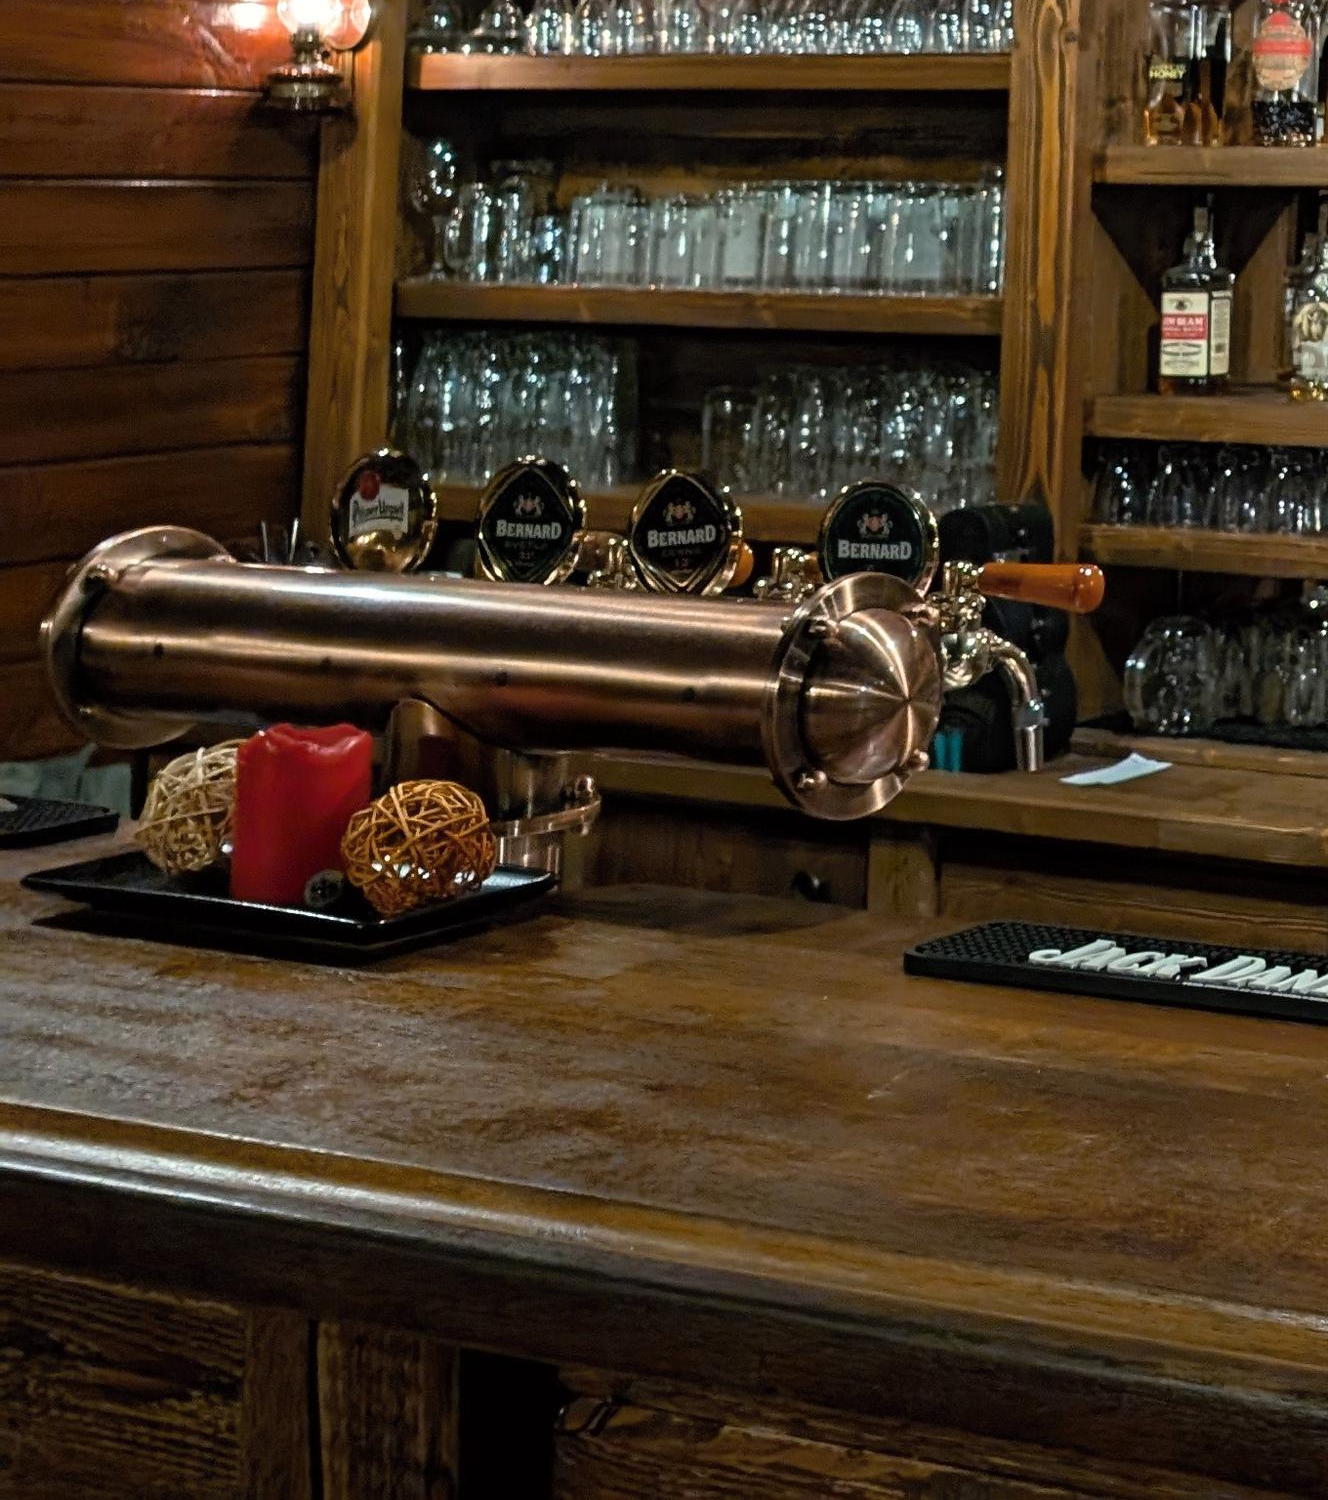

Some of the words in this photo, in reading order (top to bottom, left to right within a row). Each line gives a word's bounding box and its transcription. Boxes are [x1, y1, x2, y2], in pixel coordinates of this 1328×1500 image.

[496, 519, 562, 540] BERNARD
[647, 524, 716, 549] BERNARD
[837, 539, 912, 560] BERNARD
[1028, 939, 1208, 981] JACK
